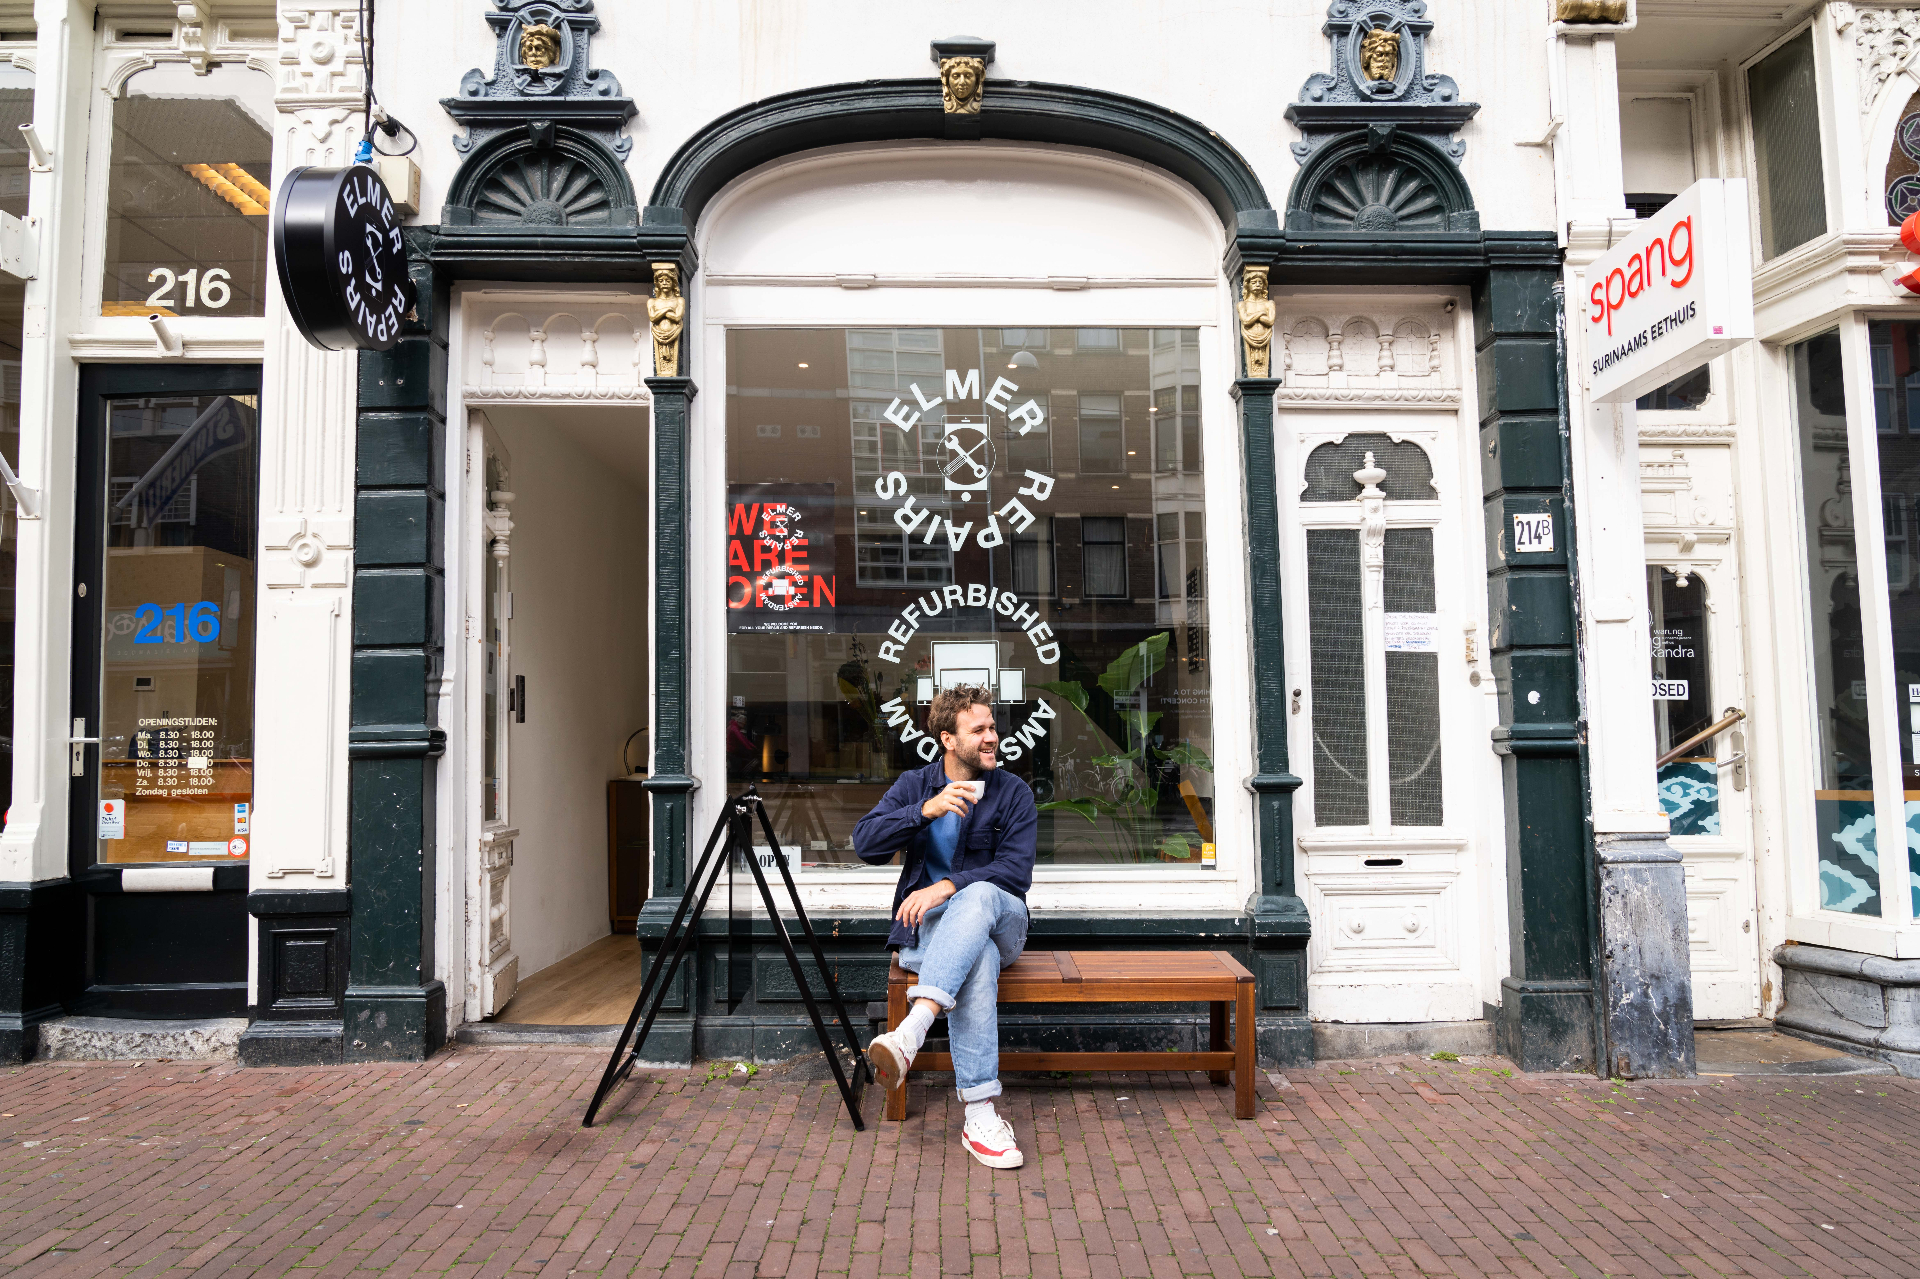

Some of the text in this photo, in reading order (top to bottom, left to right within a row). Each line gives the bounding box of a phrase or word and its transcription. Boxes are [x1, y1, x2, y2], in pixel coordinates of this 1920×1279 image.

[343, 175, 402, 255] ELMER
[145, 267, 231, 309] 216
[1590, 214, 1695, 336] spang
[338, 250, 406, 342] REPAIRS
[1592, 300, 1697, 375] SURINAAMS EETHUIS
[883, 368, 1044, 437] ELMER
[729, 503, 788, 536] WE
[761, 504, 802, 522] ELMER
[874, 468, 1056, 552] REPAIRS
[729, 538, 810, 572] ARE
[759, 529, 804, 551] REPAIRS
[728, 575, 836, 609] OPEN
[760, 565, 804, 586] REFURBISHED
[760, 592, 803, 611] AMSTERDAM
[133, 600, 221, 644] 216
[878, 583, 1061, 665] REFURBISHED
[137, 731, 153, 739] Ma.
[160, 731, 180, 739] 8.30
[190, 730, 214, 738] 18.00
[138, 717, 218, 727] OPENINGSTIJDEN:
[137, 750, 153, 758] Wo.
[158, 750, 179, 758] 8.30
[190, 750, 214, 758] 18.00
[159, 740, 179, 748] 8.30
[190, 740, 214, 748] 18.00
[136, 769, 153, 777] Vrij.
[189, 768, 213, 776] 18.00
[157, 778, 178, 786] 8.30
[136, 788, 208, 797] Zondag gesloten
